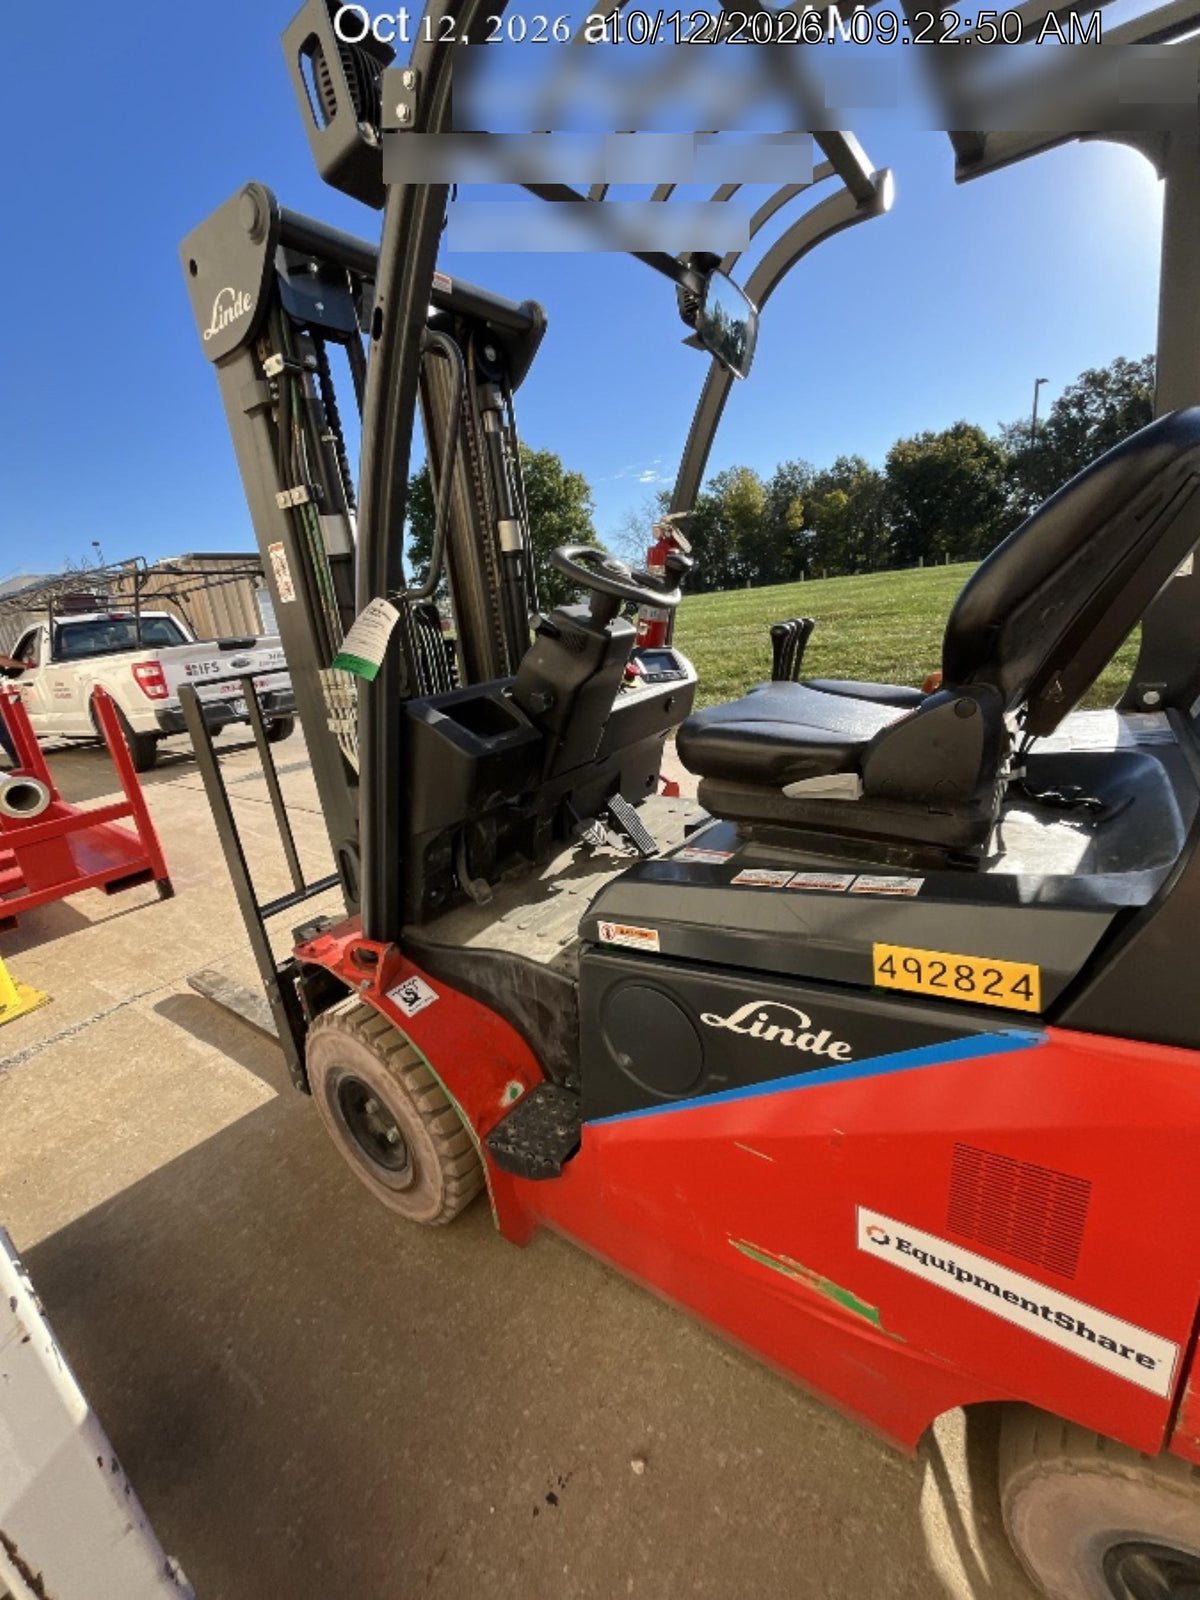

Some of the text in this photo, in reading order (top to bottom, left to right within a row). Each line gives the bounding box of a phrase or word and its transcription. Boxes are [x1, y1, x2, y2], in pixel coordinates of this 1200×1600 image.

[203, 286, 253, 341] Linde
[877, 953, 1034, 1003] 492824
[700, 1000, 853, 1061] Linde
[894, 1236, 1157, 1371] EquipmentShare
